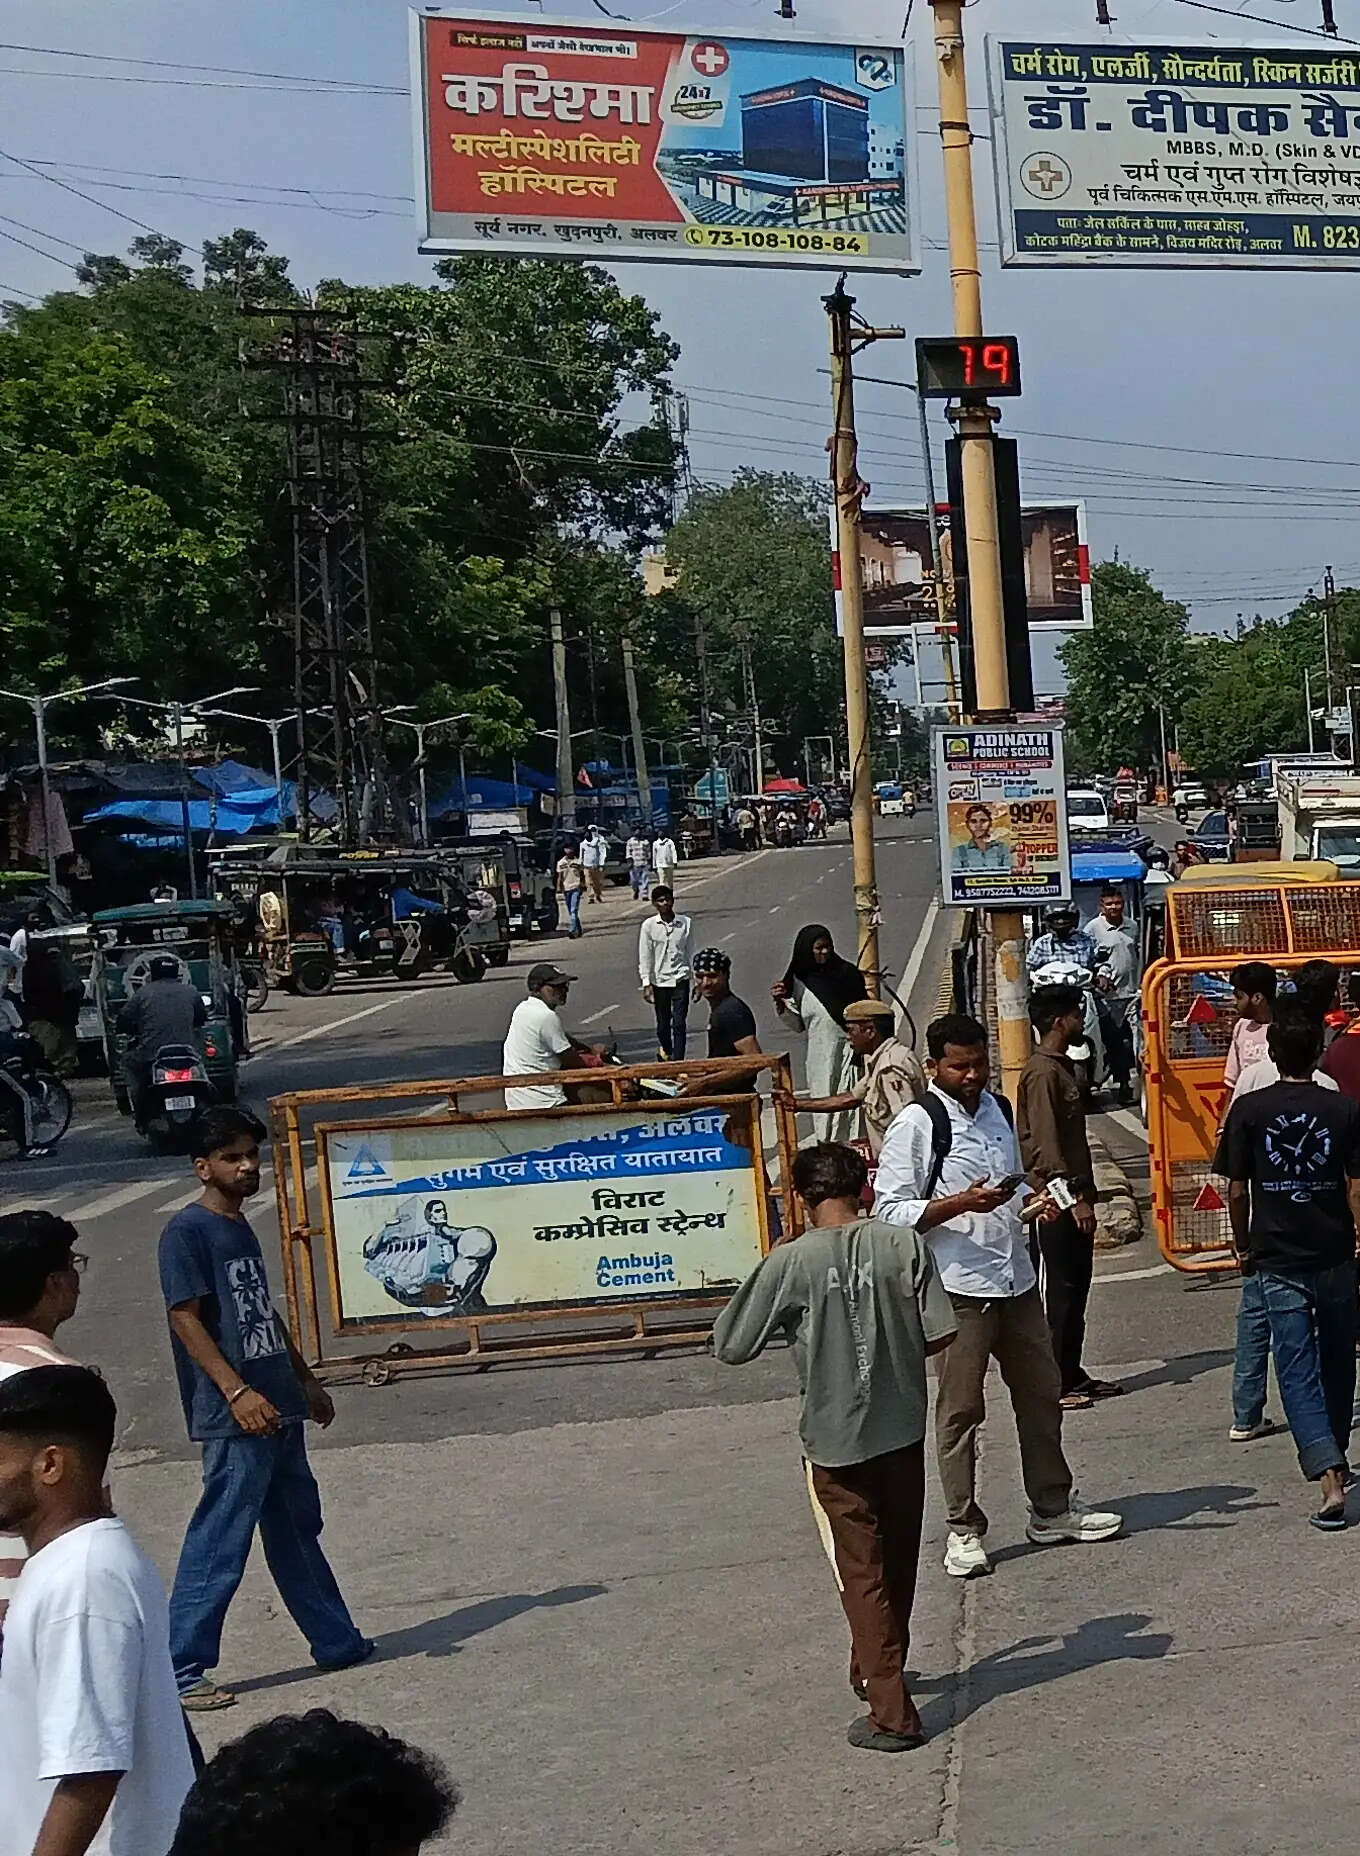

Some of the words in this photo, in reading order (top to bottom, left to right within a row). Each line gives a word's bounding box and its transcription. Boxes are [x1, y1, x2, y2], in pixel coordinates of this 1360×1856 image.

[1011, 48, 1042, 75] चर्म
[1045, 49, 1087, 81] रोग,
[1091, 51, 1157, 83] एलर्जी,
[1162, 53, 1249, 88] सौन्दर्यता,
[1253, 57, 1301, 84] स्किन
[1304, 57, 1356, 86] सर्जरी
[441, 63, 654, 123] करिश्मा
[1024, 86, 1112, 131] डॉ.
[1127, 89, 1291, 136] दीपक
[450, 130, 641, 166] मल्टीस्पेशलिटी
[1167, 140, 1222, 157] MBBS,
[1229, 142, 1269, 158] M.D.
[1275, 143, 1317, 160] (Skin
[1323, 145, 1336, 159] &
[479, 166, 618, 198] हॉस्पिटल
[1120, 158, 1159, 182] चर्म
[1163, 160, 1200, 187] एवं
[1203, 166, 1245, 189] गुप्त
[1250, 160, 1287, 185] रोग
[1087, 183, 1109, 206] पूर्व
[1113, 185, 1182, 203] चिकित्सक
[1265, 187, 1328, 209] हॉस्पिटल,
[475, 221, 500, 240] सूर्य
[631, 228, 678, 242] अलवर
[1083, 215, 1105, 230] जेल
[1144, 217, 1154, 230] के
[707, 229, 862, 252] 73-108-108-84
[1024, 232, 1058, 247] कोटक
[1094, 234, 1113, 248] बैंक
[1116, 235, 1127, 248] के
[1167, 235, 1197, 249] विजय
[1250, 239, 1282, 250] अलवर
[1292, 225, 1317, 248] M.
[974, 733, 1048, 747] ADINATH
[973, 747, 1008, 758] PUBLIC
[1011, 747, 1050, 758] SCHOOL
[1009, 801, 1054, 824] 99%
[1026, 843, 1058, 854] TOPPER
[488, 1156, 529, 1184] एवं
[534, 1151, 615, 1180] सुरक्षित
[622, 1147, 723, 1172] यातायात
[591, 1188, 665, 1211] विराट
[533, 1215, 650, 1242] कम्प्रेसिव
[656, 1209, 727, 1236] स्ट्रेन्थ
[596, 1252, 673, 1271] Ambuja
[597, 1268, 676, 1288] Cement
